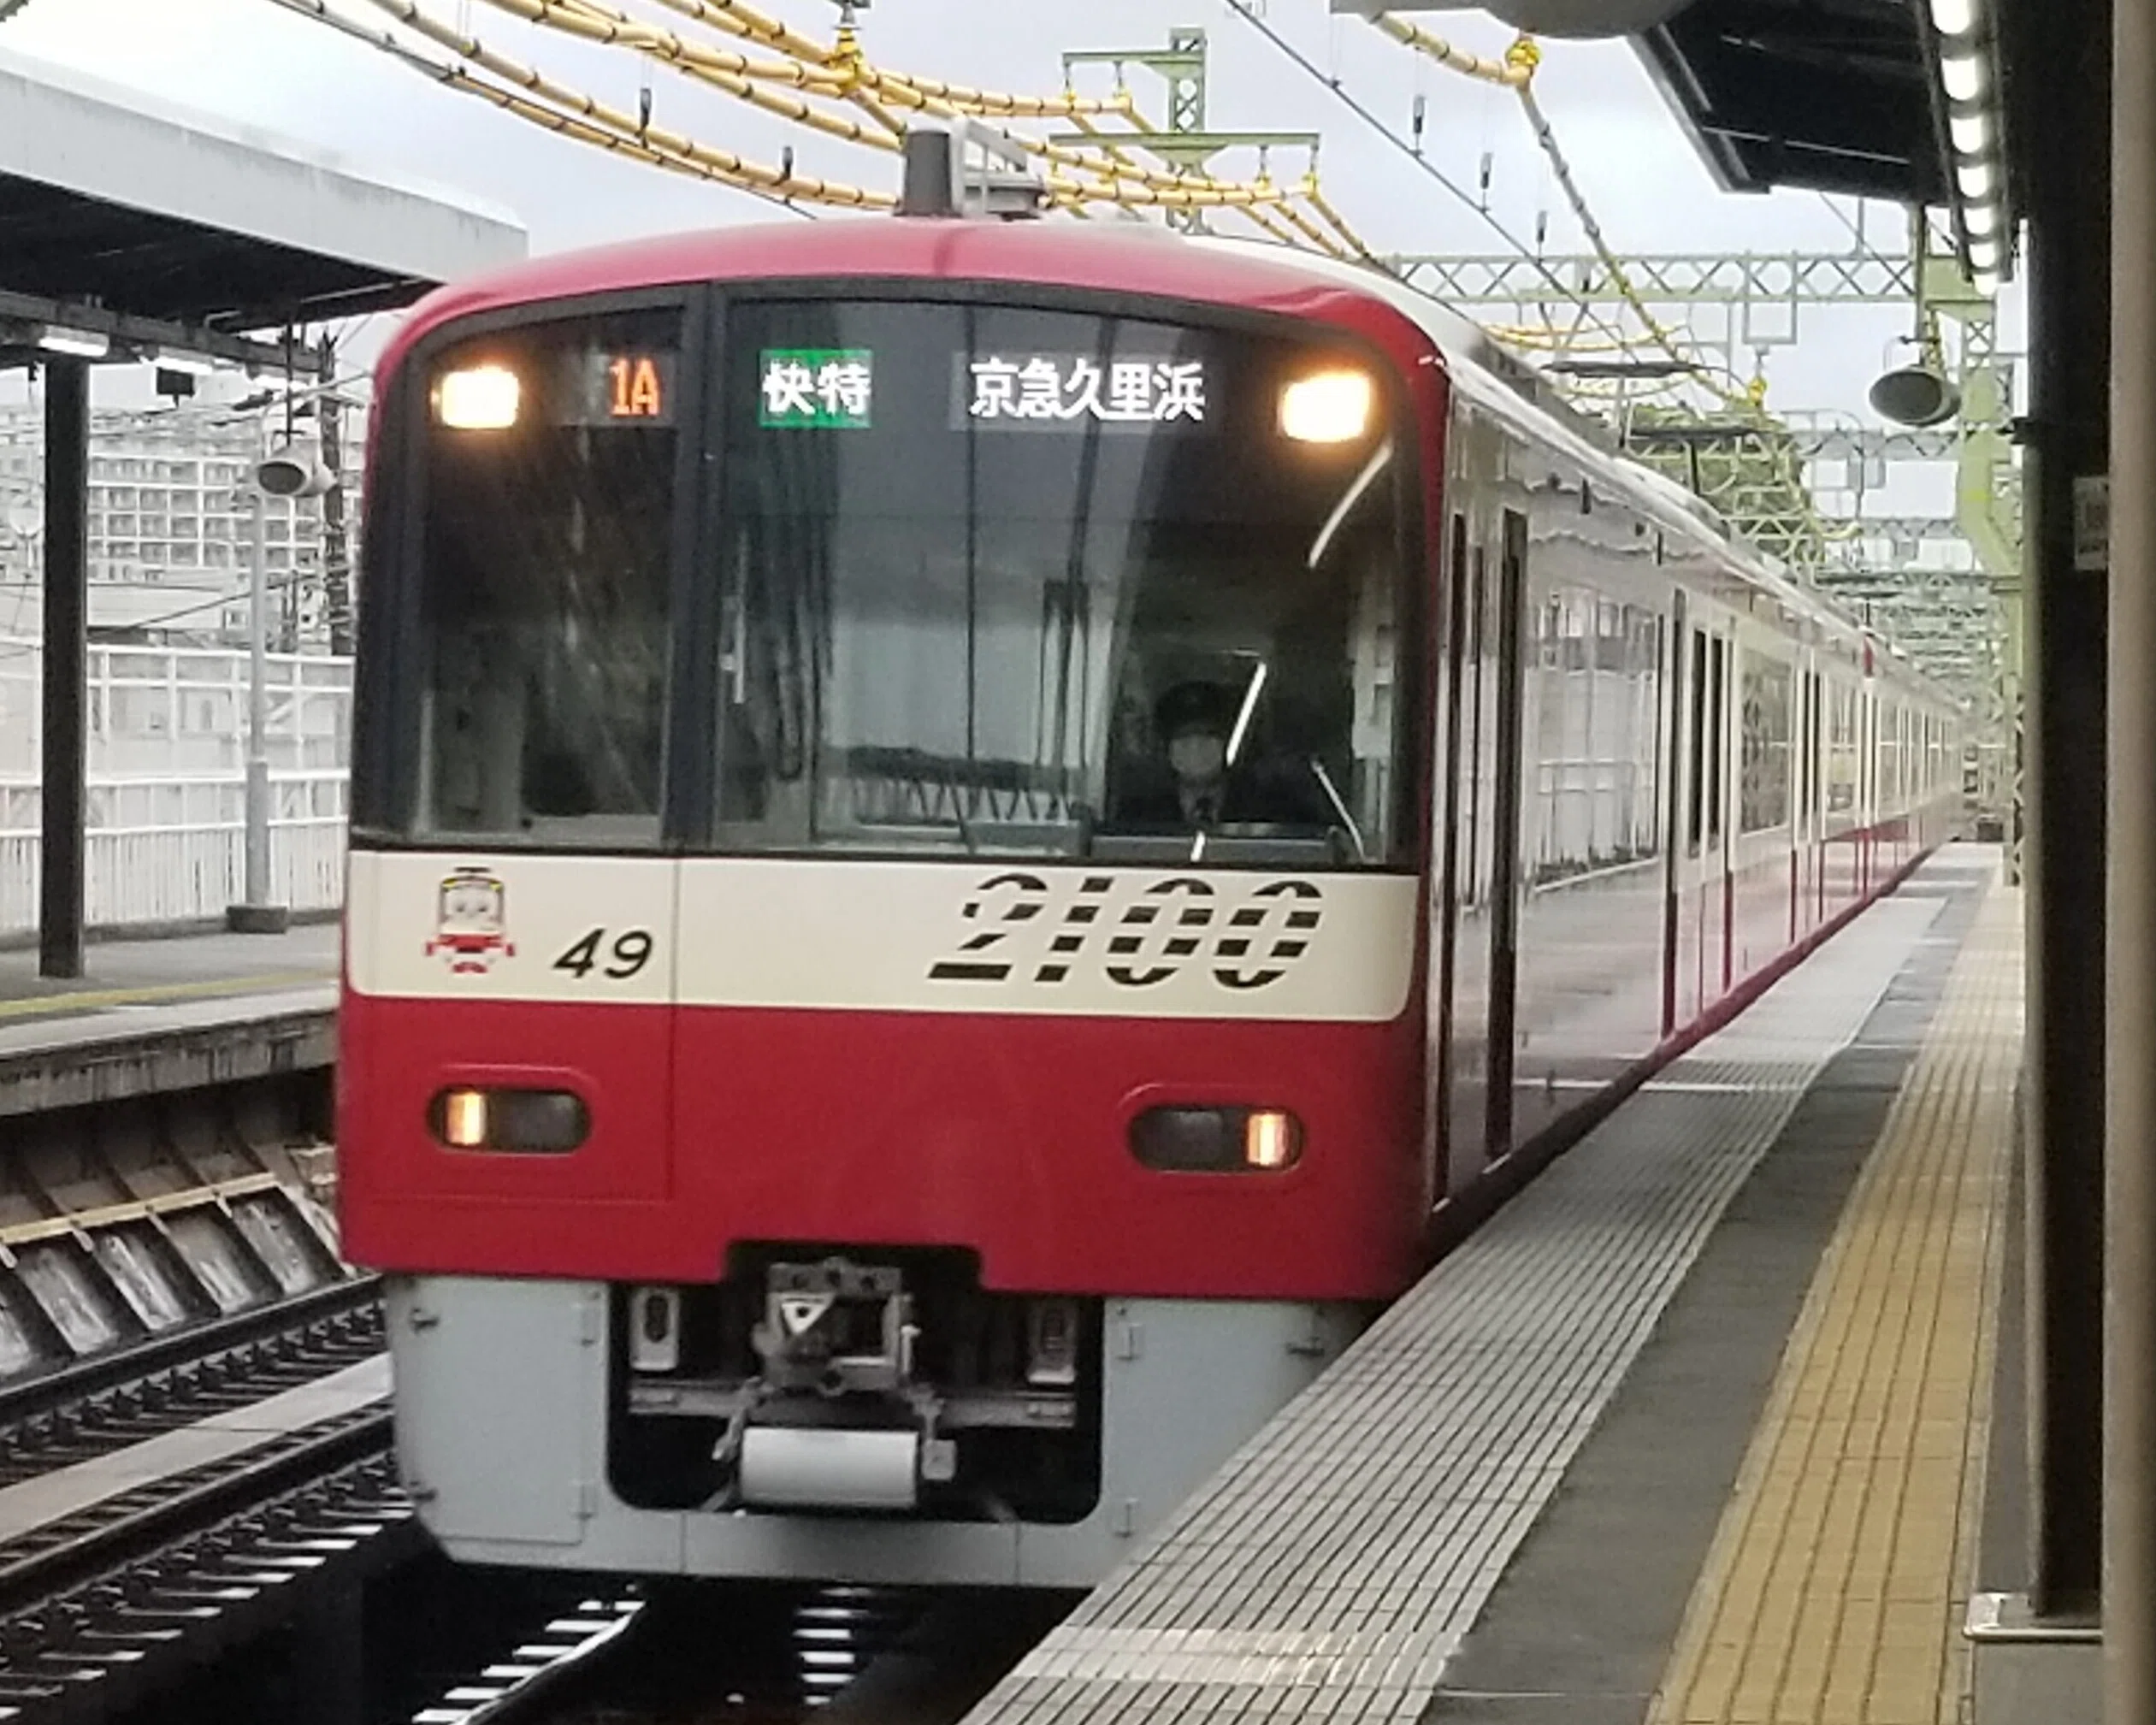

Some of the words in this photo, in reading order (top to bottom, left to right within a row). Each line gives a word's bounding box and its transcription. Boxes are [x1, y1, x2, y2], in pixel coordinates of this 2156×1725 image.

[608, 357, 662, 417] 1A
[761, 362, 872, 416] 快特
[970, 356, 1206, 422] 京急久里浜
[553, 928, 653, 980] 49
[926, 873, 1324, 990] 2100
